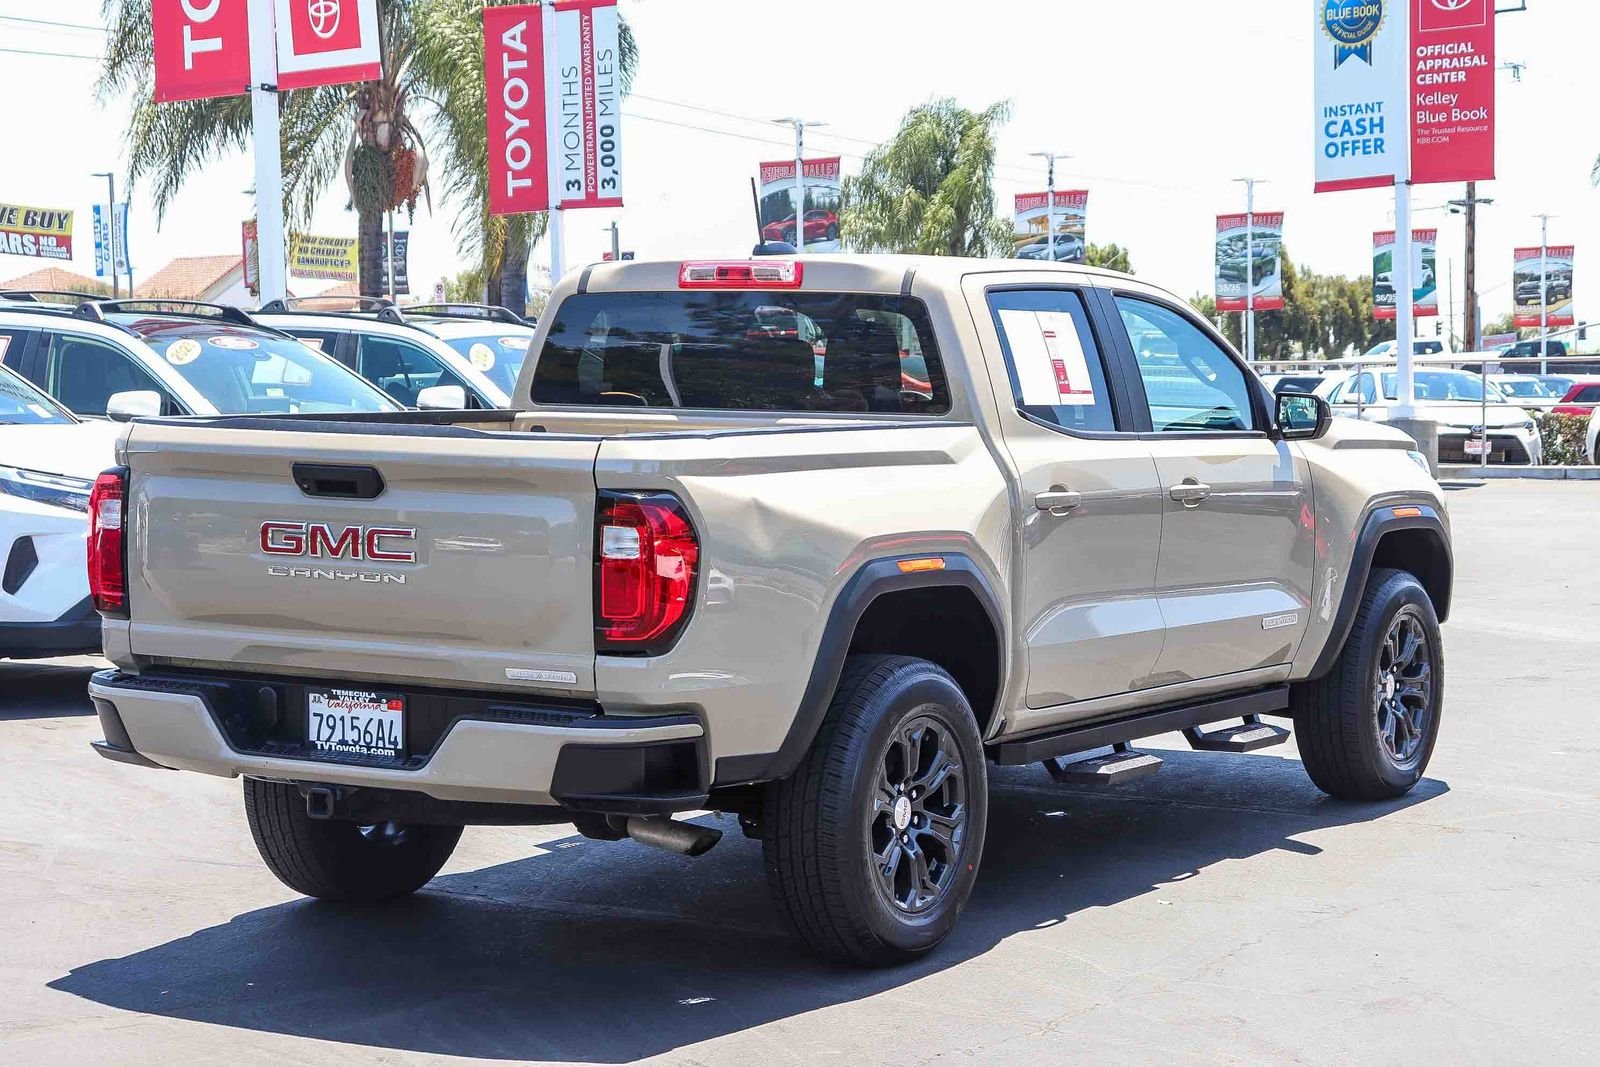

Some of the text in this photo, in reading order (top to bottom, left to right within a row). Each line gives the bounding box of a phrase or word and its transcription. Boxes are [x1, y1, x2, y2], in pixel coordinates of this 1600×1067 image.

[1326, 4, 1380, 21] BLUE BOOK
[1332, 23, 1357, 39] OFFICIAL
[1416, 42, 1475, 57] OFFICIAL
[1416, 55, 1488, 71] APPRAISAL
[1416, 71, 1466, 85] CENTER
[582, 14, 595, 193] POWERTRAIN LIMITED WARRANTY
[1416, 92, 1458, 106] Kelley
[502, 20, 532, 197] TOYOTA
[1324, 102, 1384, 118] INSTANT
[1416, 107, 1488, 124] Blue Book
[597, 49, 618, 190] 3,000 MILES
[1324, 116, 1385, 139] CASH
[562, 66, 581, 192] 3 MONTHS
[1417, 124, 1489, 136] The Trusted Resource
[1324, 137, 1385, 158] OFFER
[1417, 136, 1450, 145] KBB.COM
[803, 162, 839, 181] VALLEY
[23, 208, 70, 231] BUY
[102, 222, 110, 262] CARS
[260, 520, 417, 563] GMC
[267, 565, 407, 585] CANYON
[331, 689, 377, 699] TEMECULA
[339, 695, 370, 703] VALLEY
[312, 712, 399, 748] 79156A4
[315, 740, 395, 757] TVToyota.com
